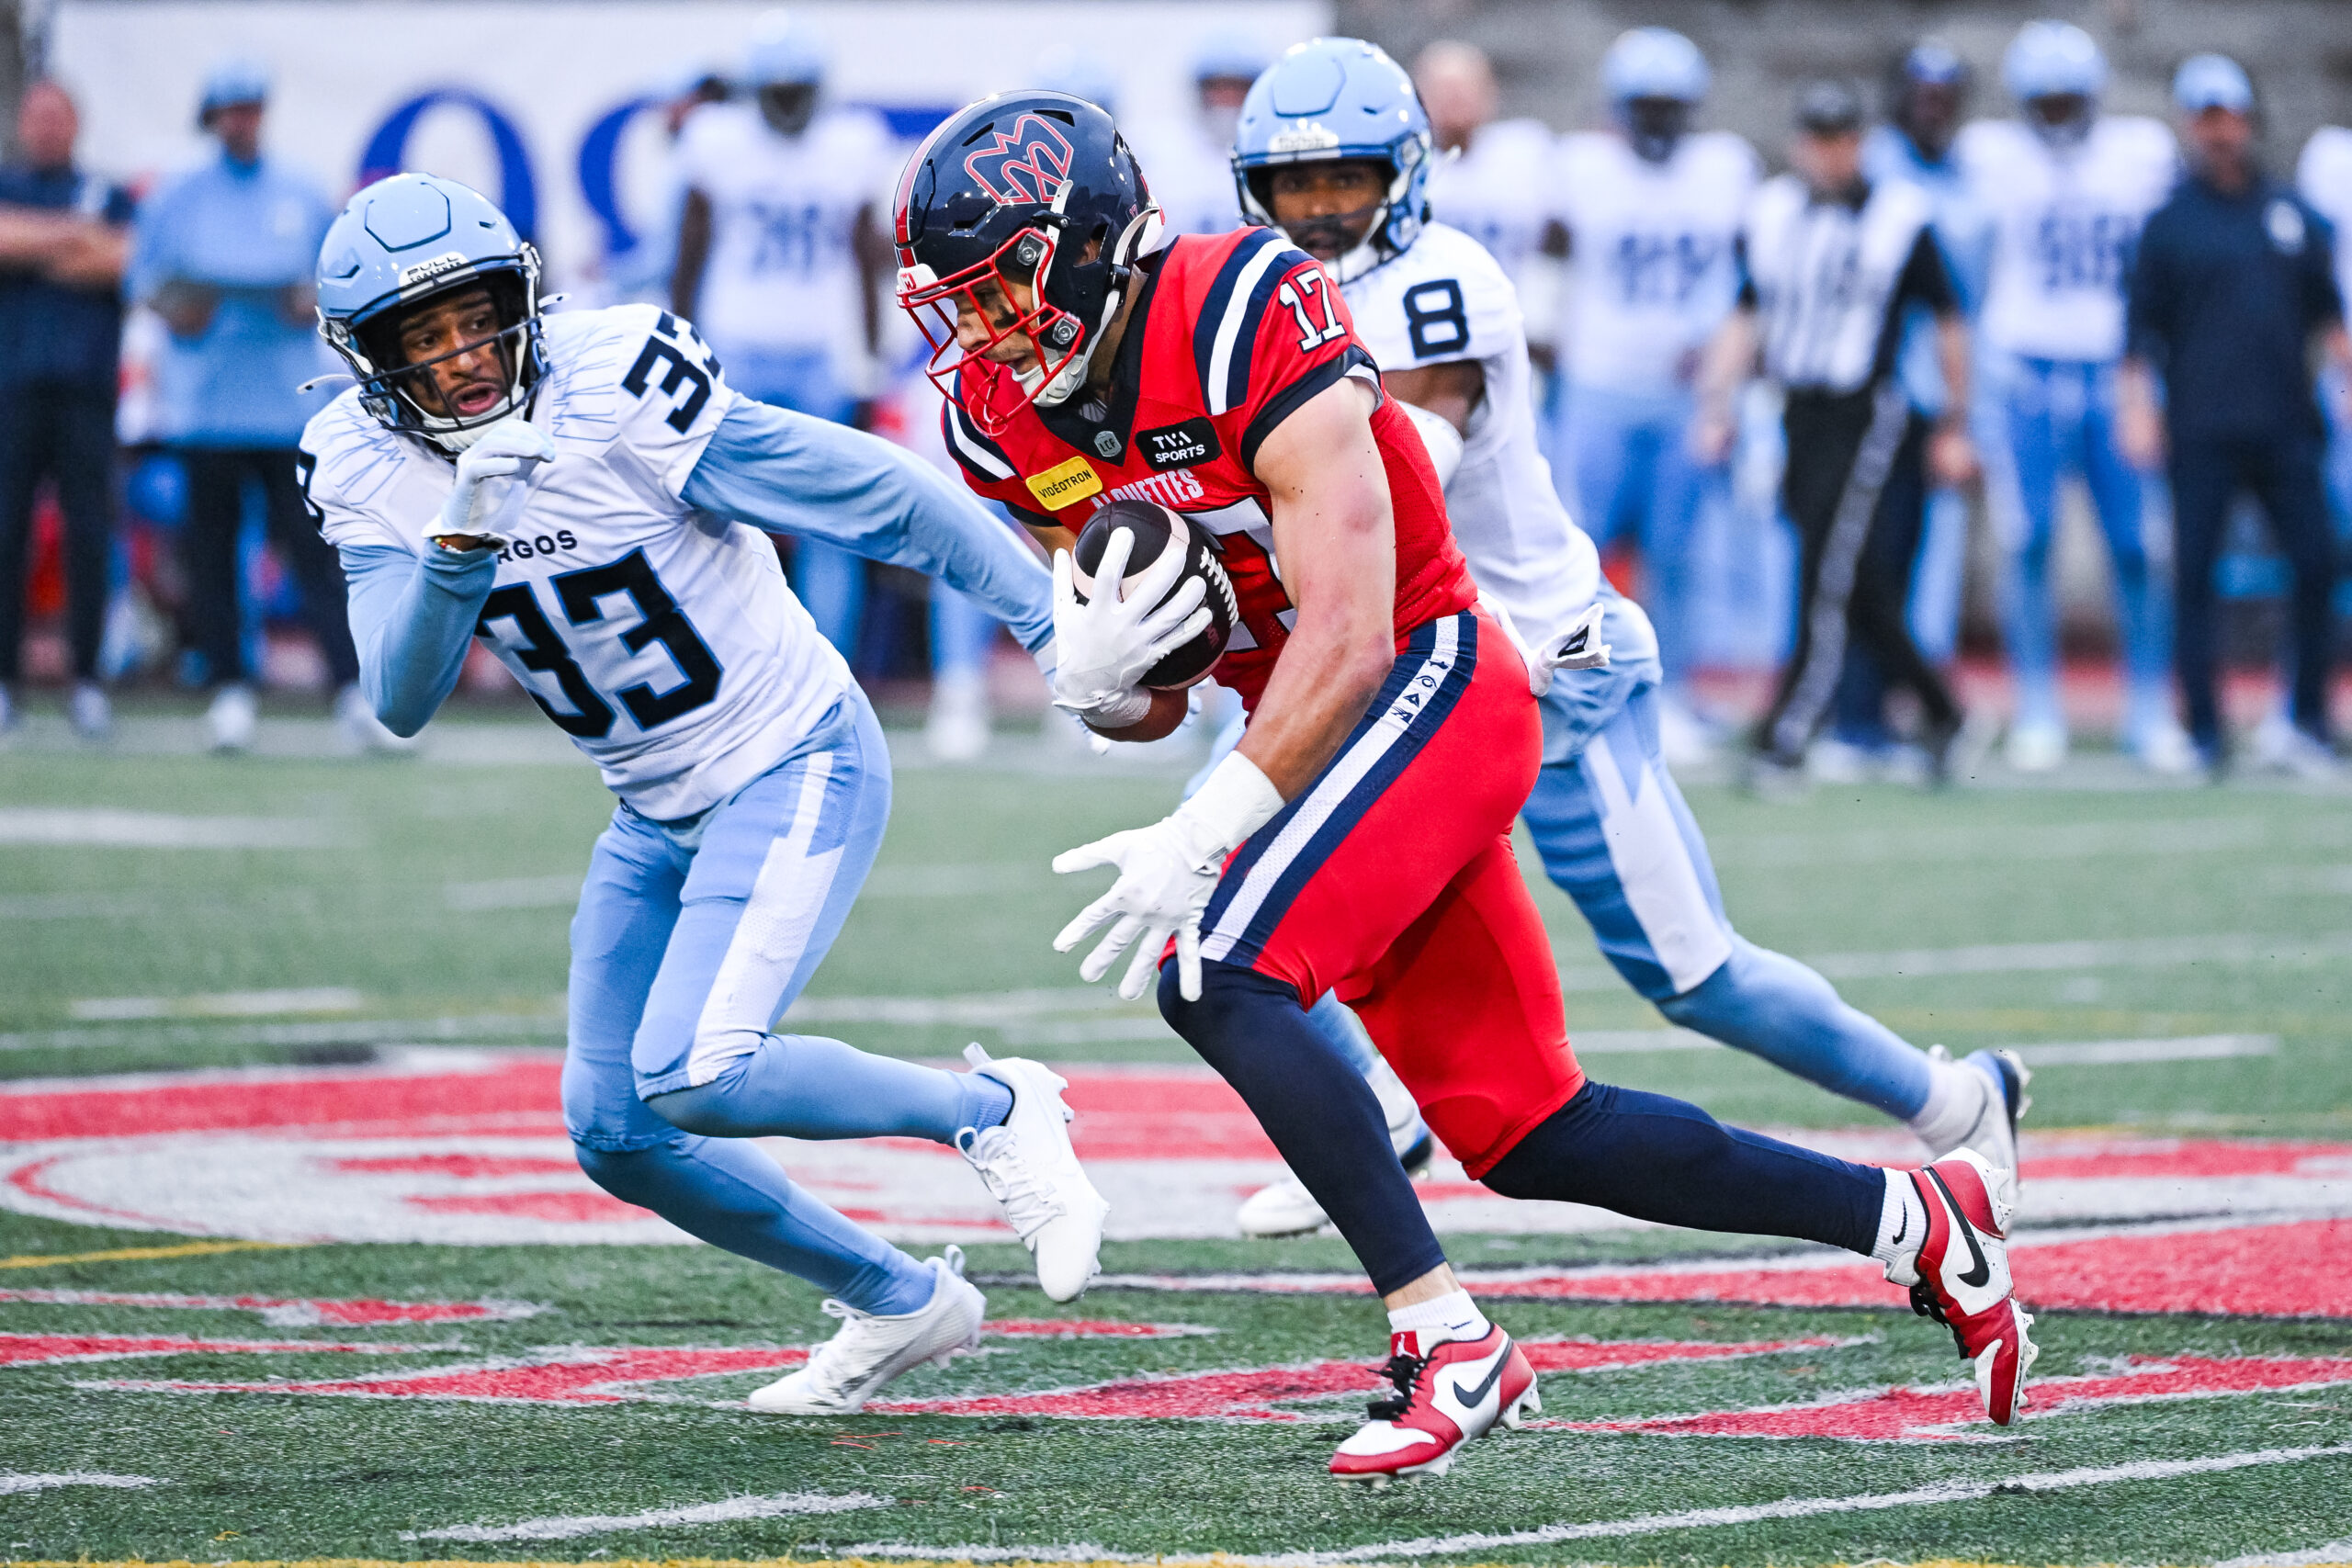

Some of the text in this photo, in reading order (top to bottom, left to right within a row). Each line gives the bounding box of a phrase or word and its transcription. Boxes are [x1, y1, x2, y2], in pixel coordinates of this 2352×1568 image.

[407, 257, 459, 276] PULL
[1279, 267, 1348, 355] 17
[1403, 278, 1470, 359] 8
[1099, 437, 1116, 453] LCF
[1152, 431, 1193, 449] TVA
[1155, 444, 1206, 463] SPORTS
[1038, 469, 1092, 499] VIDÉOTRON
[497, 530, 578, 565] RGOS
[474, 546, 725, 739] 33
